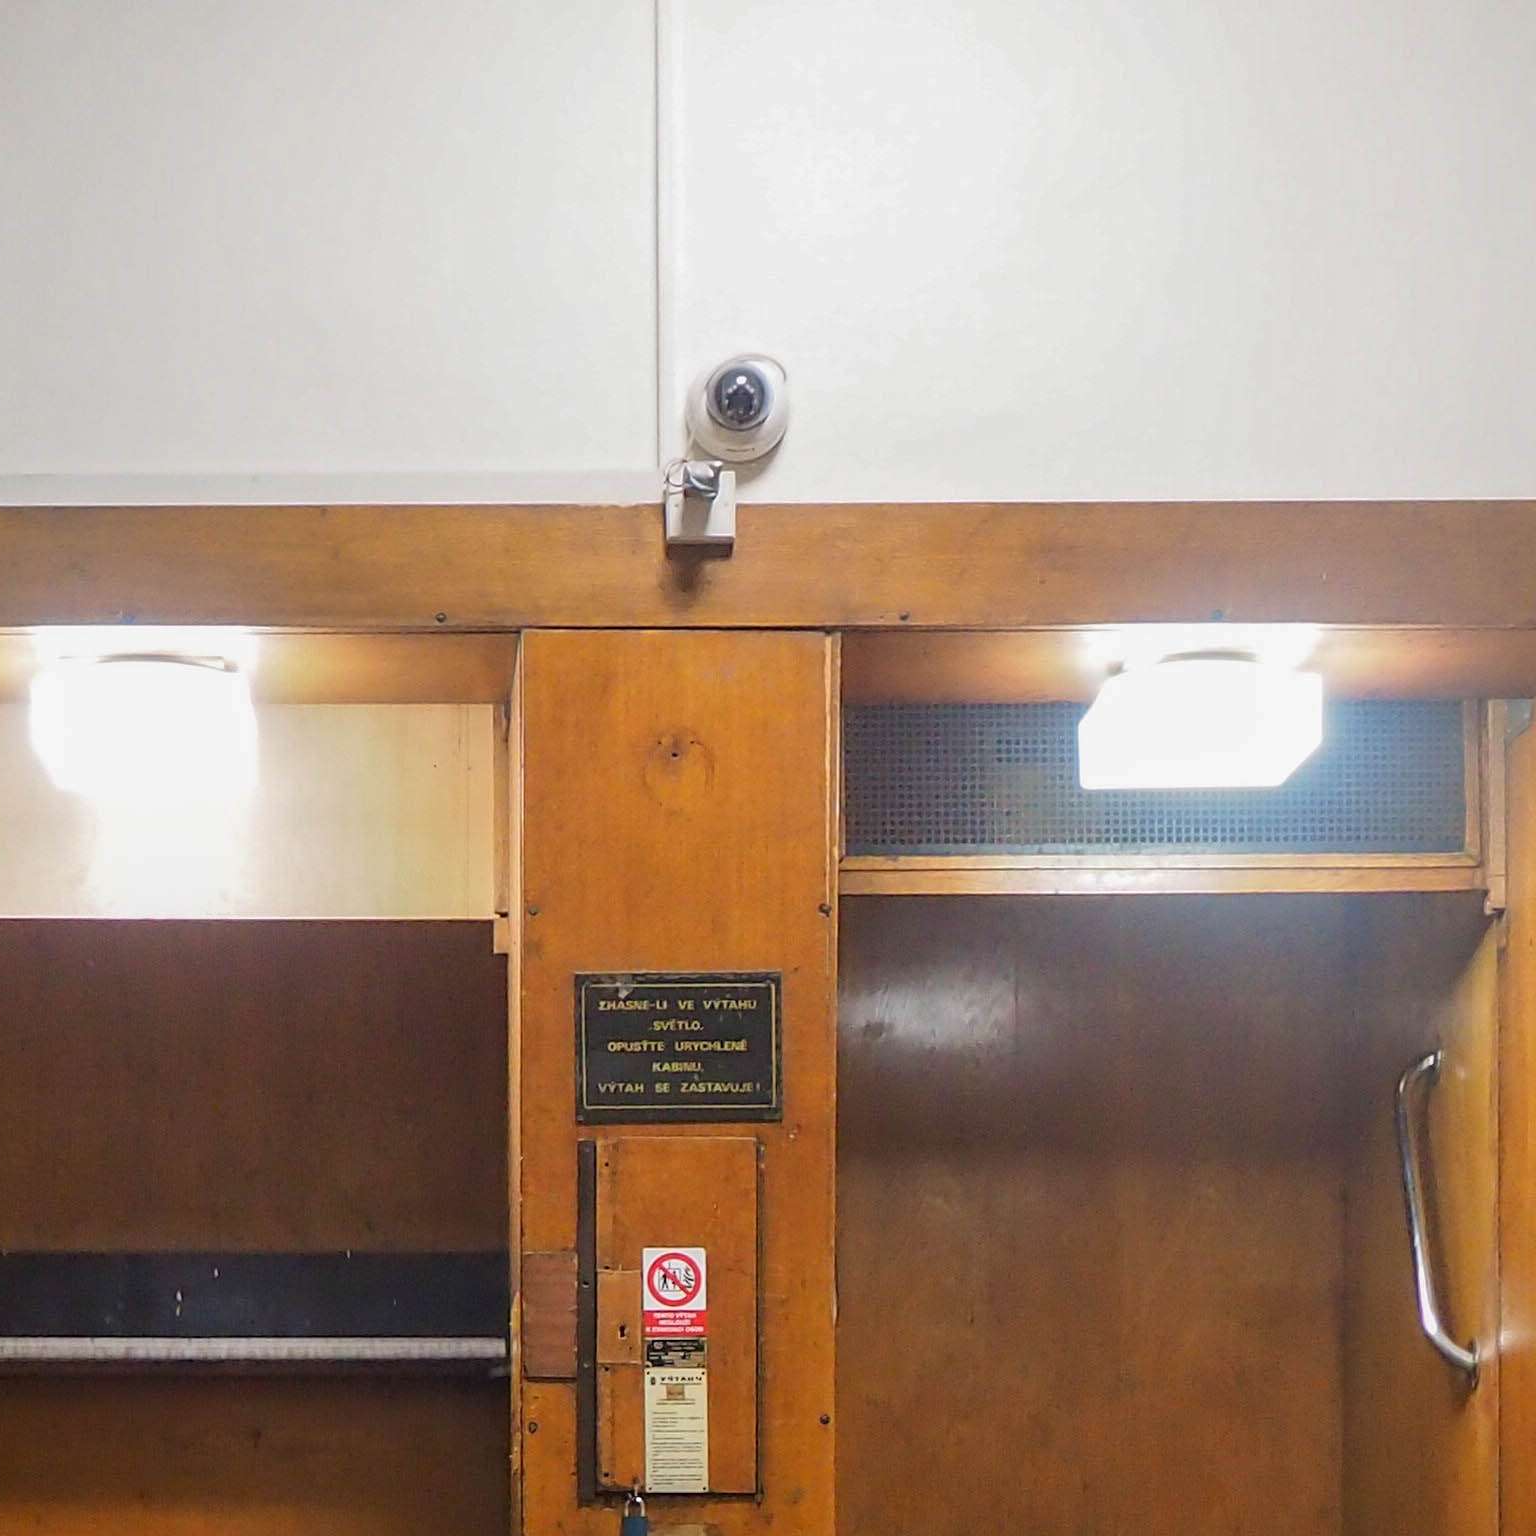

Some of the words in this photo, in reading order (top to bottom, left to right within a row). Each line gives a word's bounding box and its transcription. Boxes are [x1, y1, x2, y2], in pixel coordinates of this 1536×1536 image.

[598, 1000, 667, 1010] ZHASNE-LI
[678, 1000, 695, 1010] VE
[703, 998, 757, 1010] VÝTAHU
[598, 1081, 644, 1093] VÝTAH
[655, 1083, 670, 1093] SE
